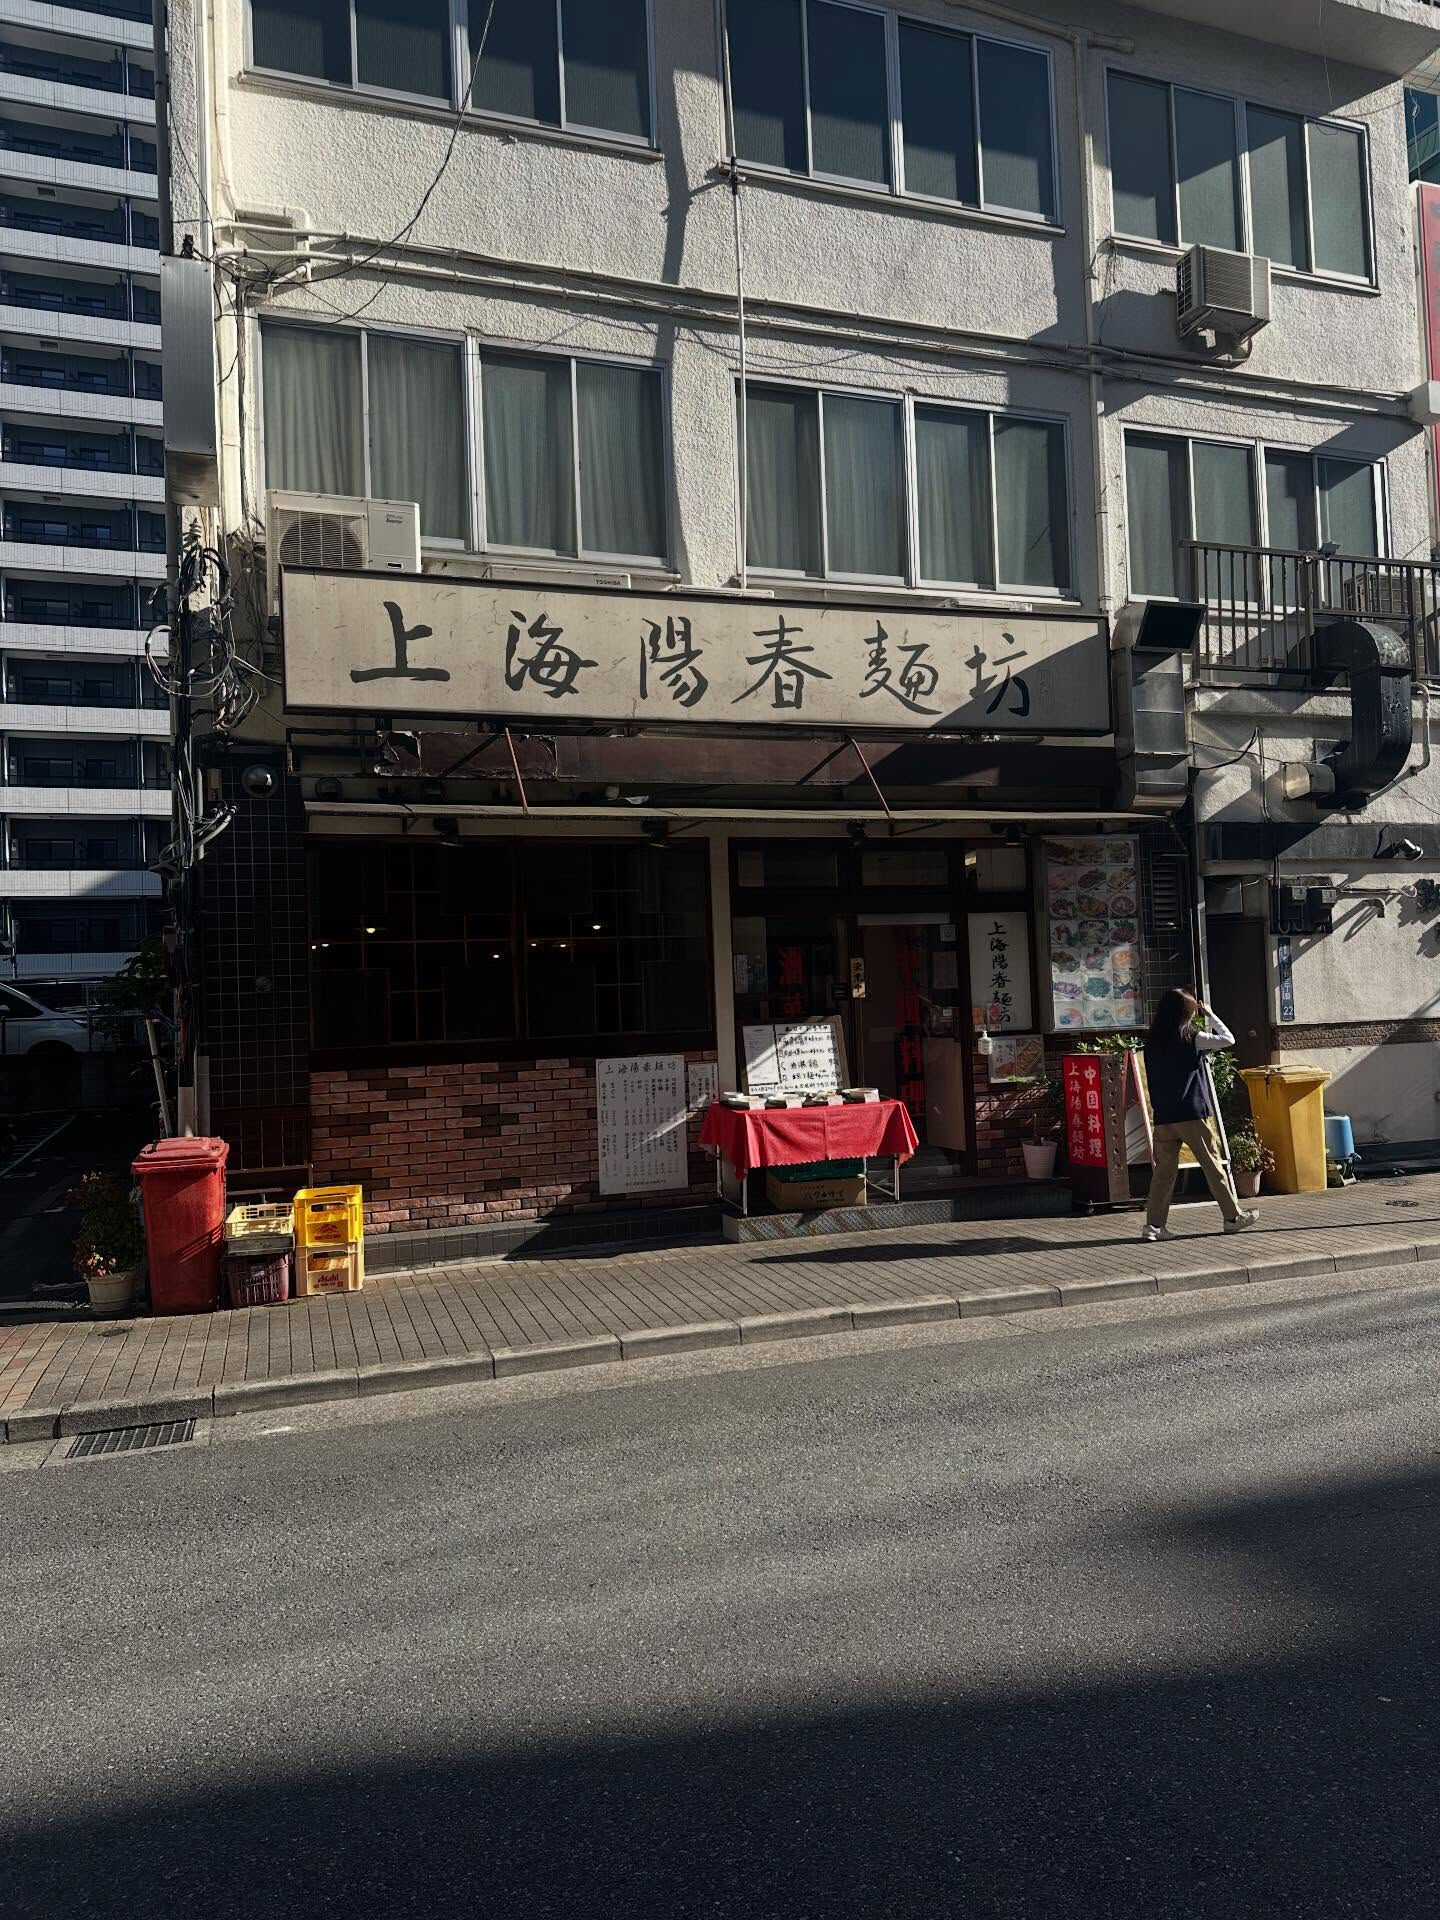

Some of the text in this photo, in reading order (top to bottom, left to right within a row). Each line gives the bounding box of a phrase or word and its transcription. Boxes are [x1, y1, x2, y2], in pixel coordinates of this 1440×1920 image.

[1283, 1006, 1294, 1016] 22
[1083, 1065, 1103, 1158] 中国料理
[317, 1272, 339, 1283] Asahi
